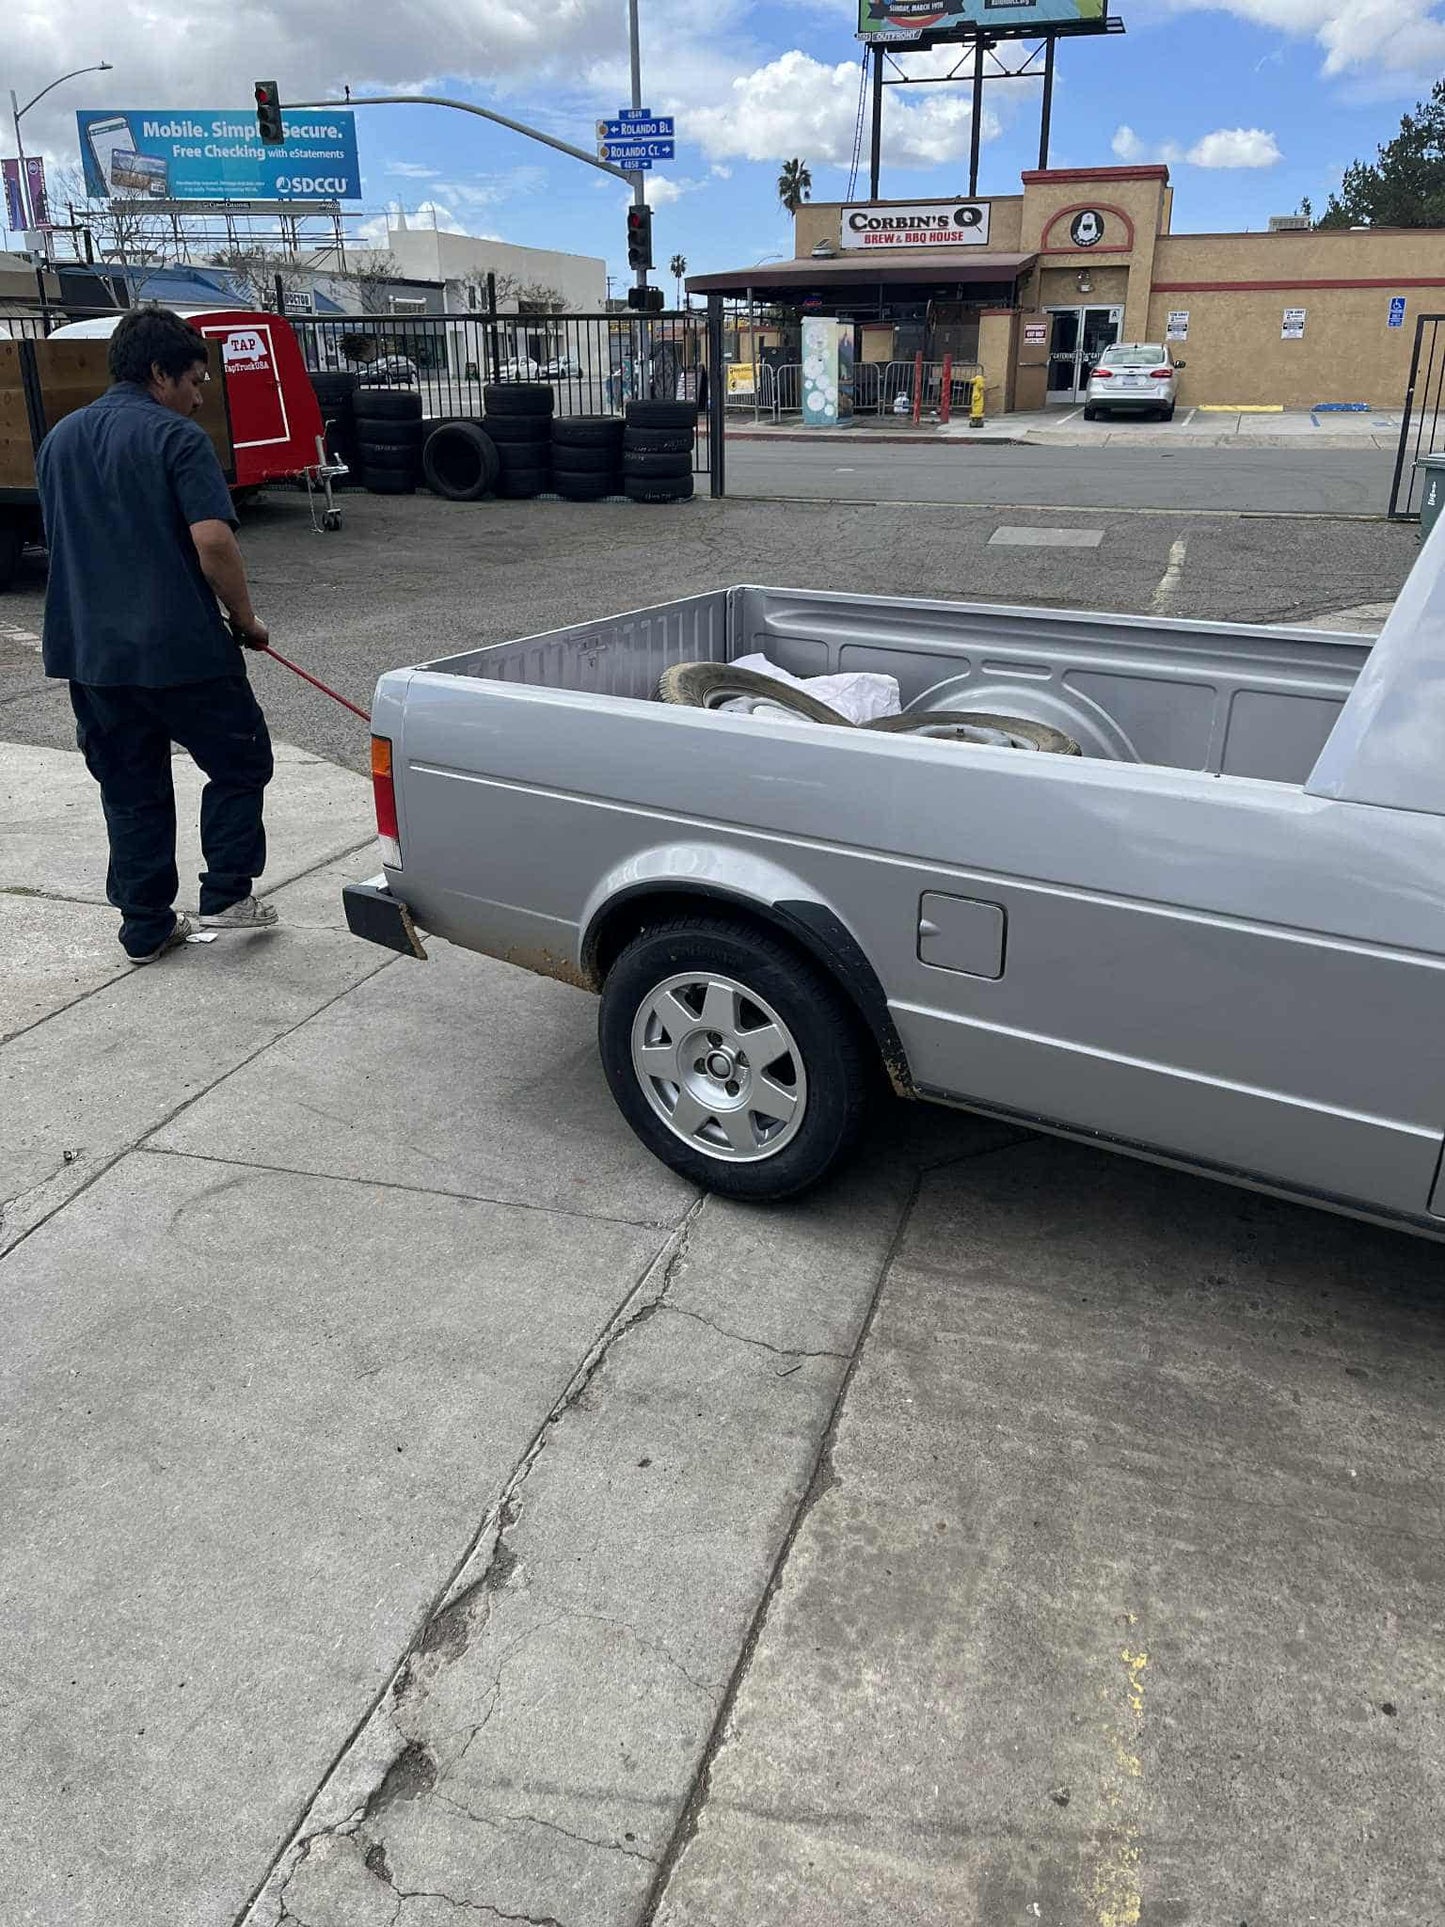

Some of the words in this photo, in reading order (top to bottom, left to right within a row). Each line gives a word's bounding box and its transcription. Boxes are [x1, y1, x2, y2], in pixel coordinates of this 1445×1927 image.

[912, 3, 931, 11] MARCH
[143, 121, 208, 138] Mobile.
[212, 121, 261, 142] Simpl
[282, 122, 343, 139] Secure.
[621, 122, 657, 135] ROLANDO
[172, 144, 201, 158] Free
[204, 144, 266, 161] Checking
[268, 149, 288, 159] with
[289, 148, 345, 160] eStatements
[611, 145, 647, 158] ROLANDO
[292, 177, 347, 193] SDCCU
[848, 212, 949, 231] CORBIN'S
[864, 233, 895, 244] BREW
[905, 231, 927, 244] BBQ
[929, 231, 964, 243] HOUSE
[231, 338, 256, 351] TAP
